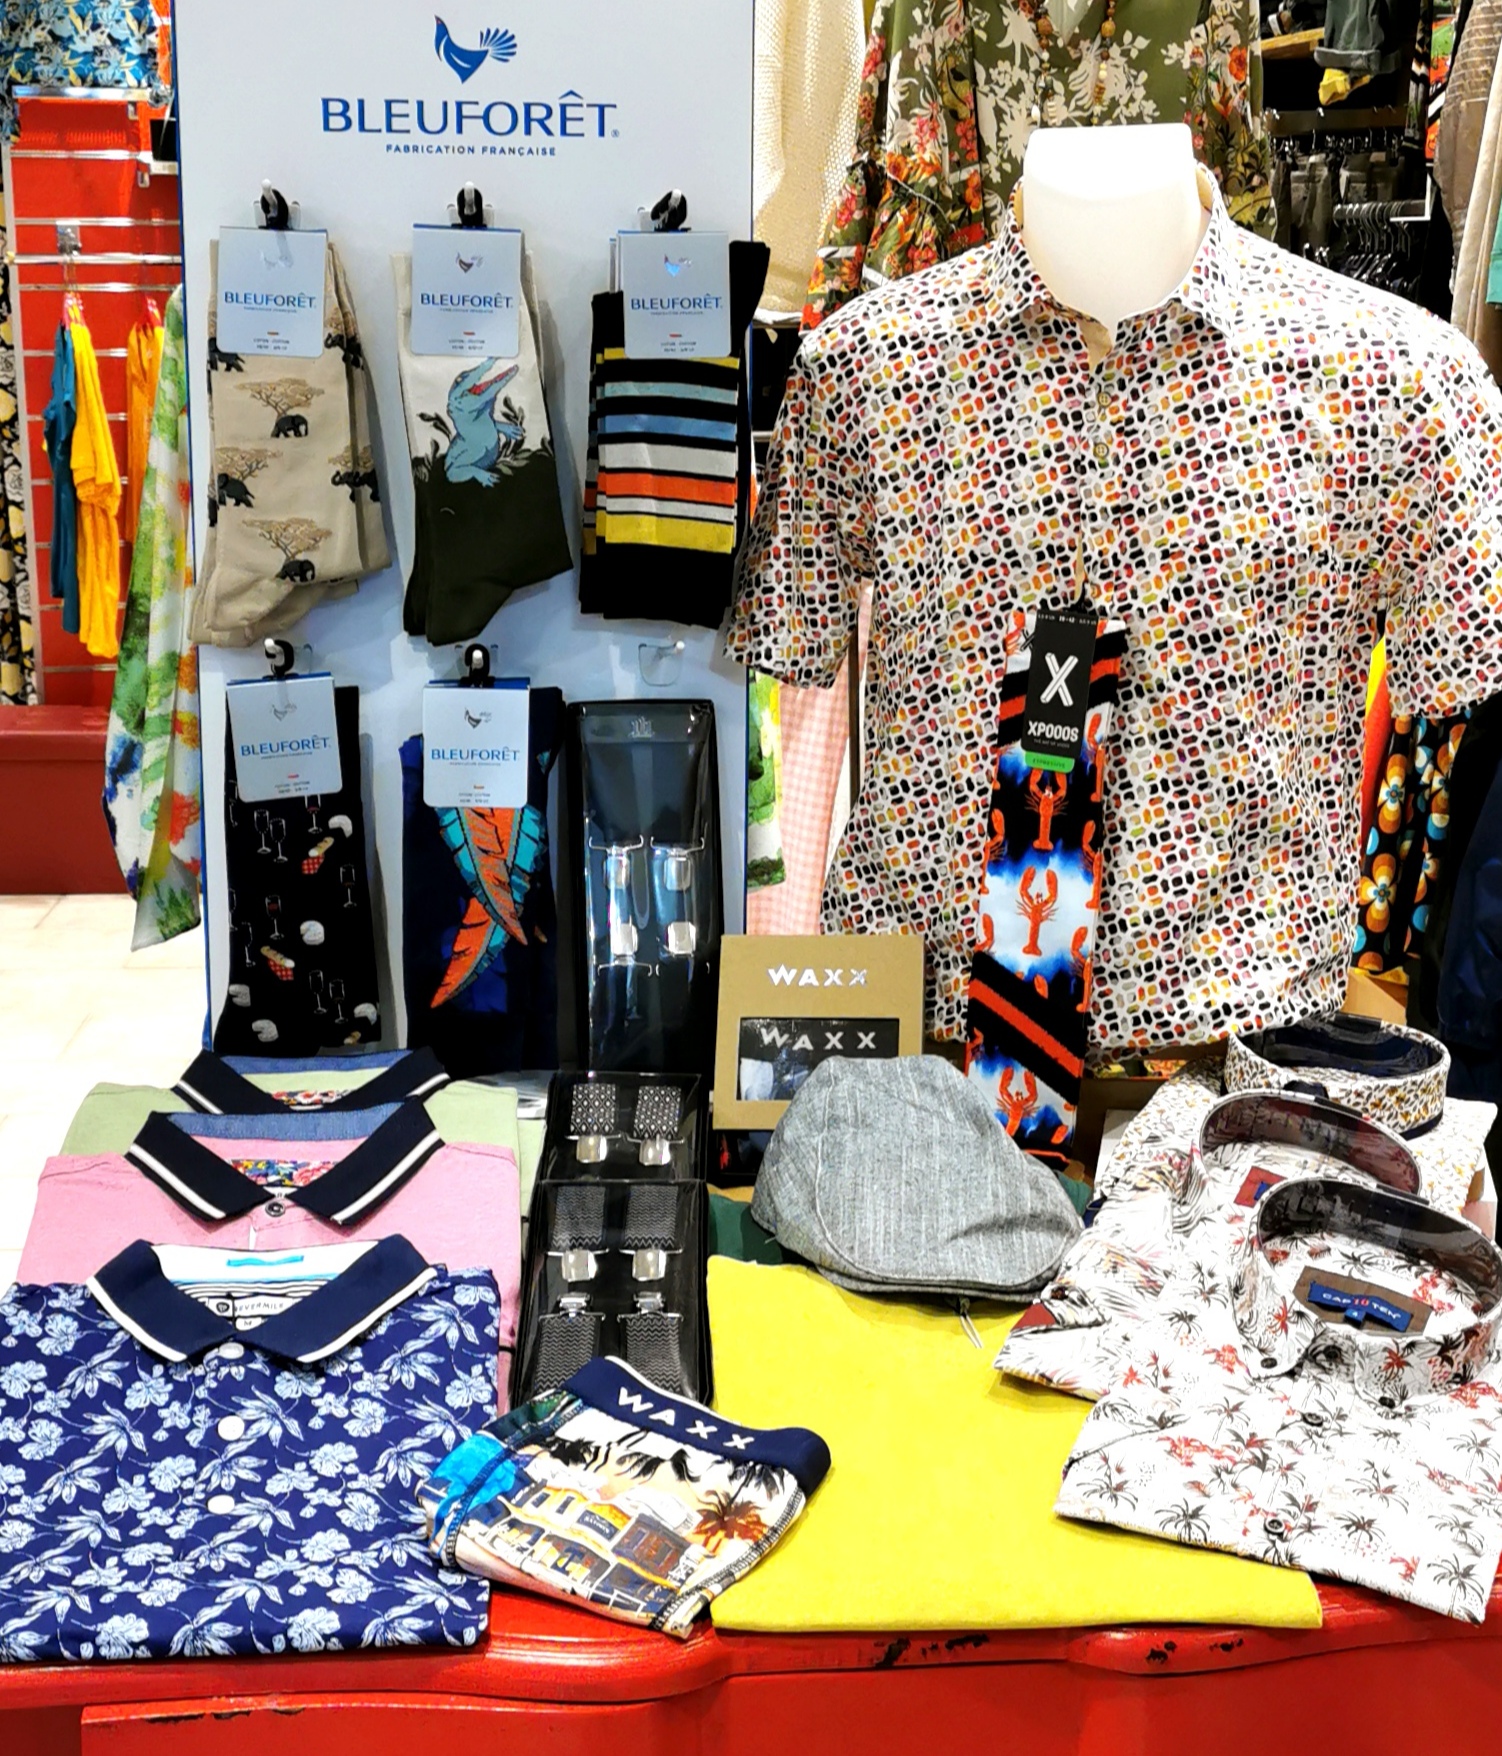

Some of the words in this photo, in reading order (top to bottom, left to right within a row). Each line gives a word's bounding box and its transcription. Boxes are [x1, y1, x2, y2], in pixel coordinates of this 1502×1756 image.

[321, 90, 617, 138] BLEUFORÊT
[386, 144, 475, 155] FABRICATION
[481, 145, 556, 157] FRANÇAISE
[224, 291, 316, 308] BLEUFORÊT
[420, 292, 513, 308] BLEUFORÊT
[631, 293, 722, 310] BLEUFORÊT
[1027, 720, 1079, 742] XPOOOS
[240, 734, 330, 757] BLEUFORÊT
[431, 746, 520, 761] BLEUFORÊT
[768, 964, 867, 987] WAXX
[761, 1026, 876, 1050] WAXX
[1322, 1292, 1351, 1304] CAP
[1371, 1301, 1401, 1320] TEN
[618, 1386, 755, 1451] WAXX
